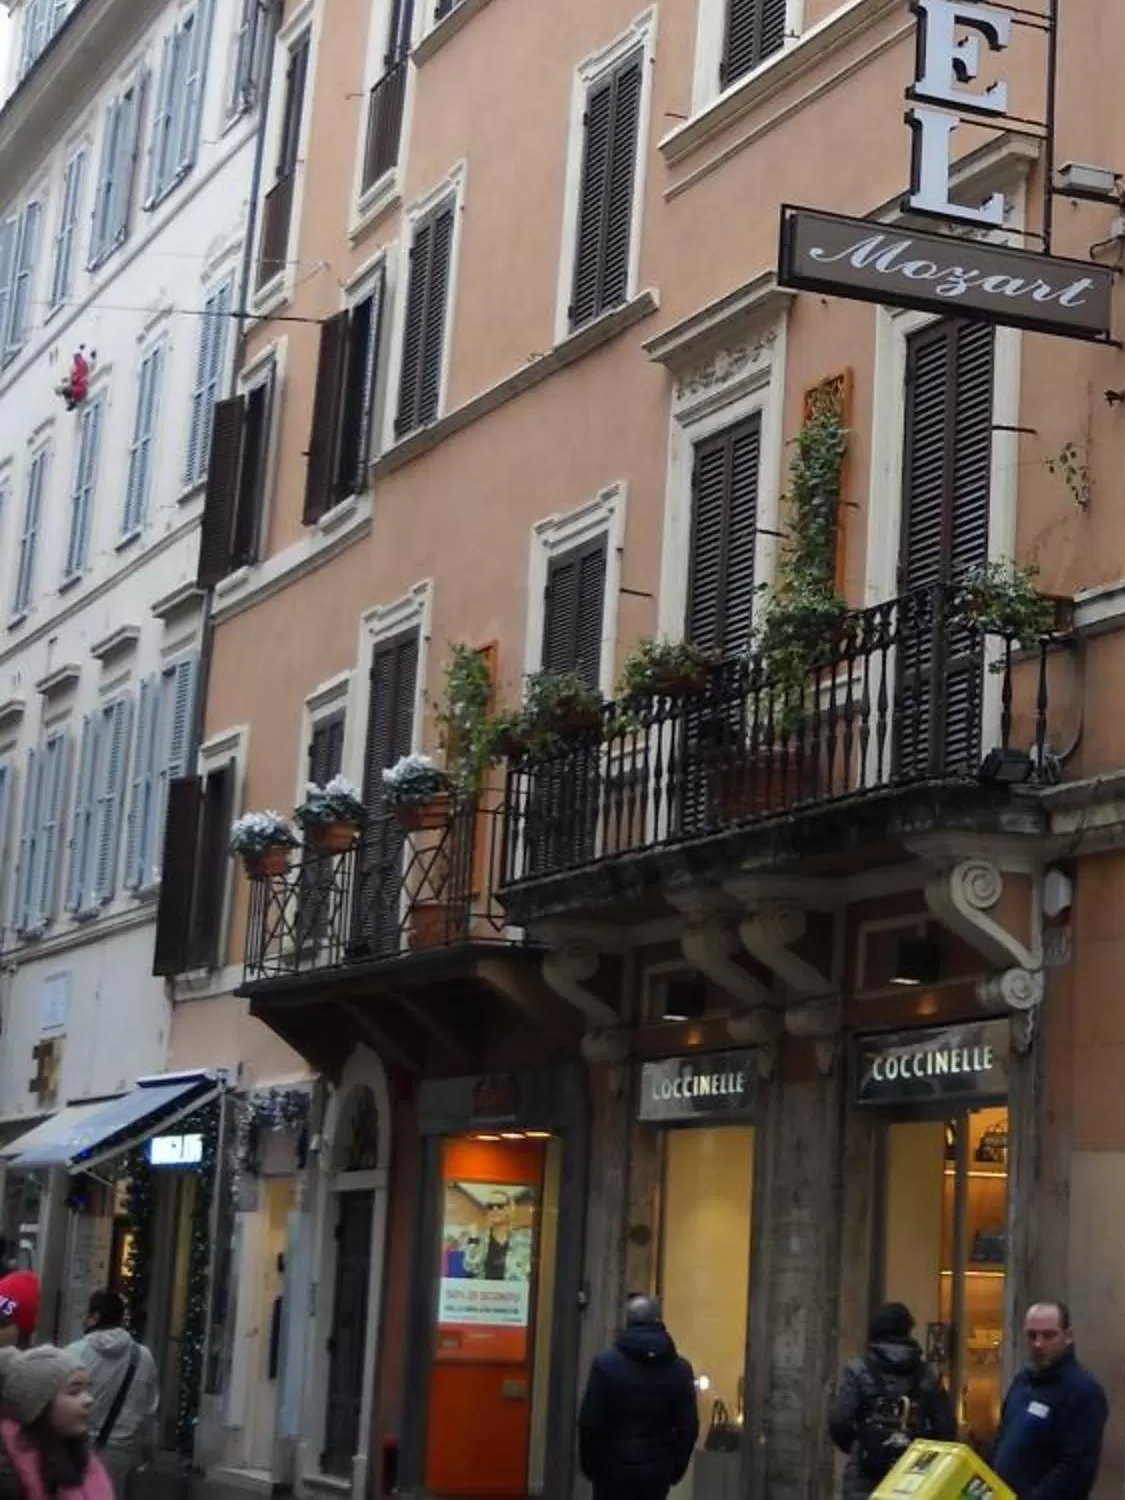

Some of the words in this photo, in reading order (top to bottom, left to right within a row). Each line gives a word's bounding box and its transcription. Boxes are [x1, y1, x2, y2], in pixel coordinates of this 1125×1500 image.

[809, 234, 1095, 307] Mozart
[873, 1046, 993, 1081] COCCINELLE
[652, 1071, 745, 1100] COCCINELLE
